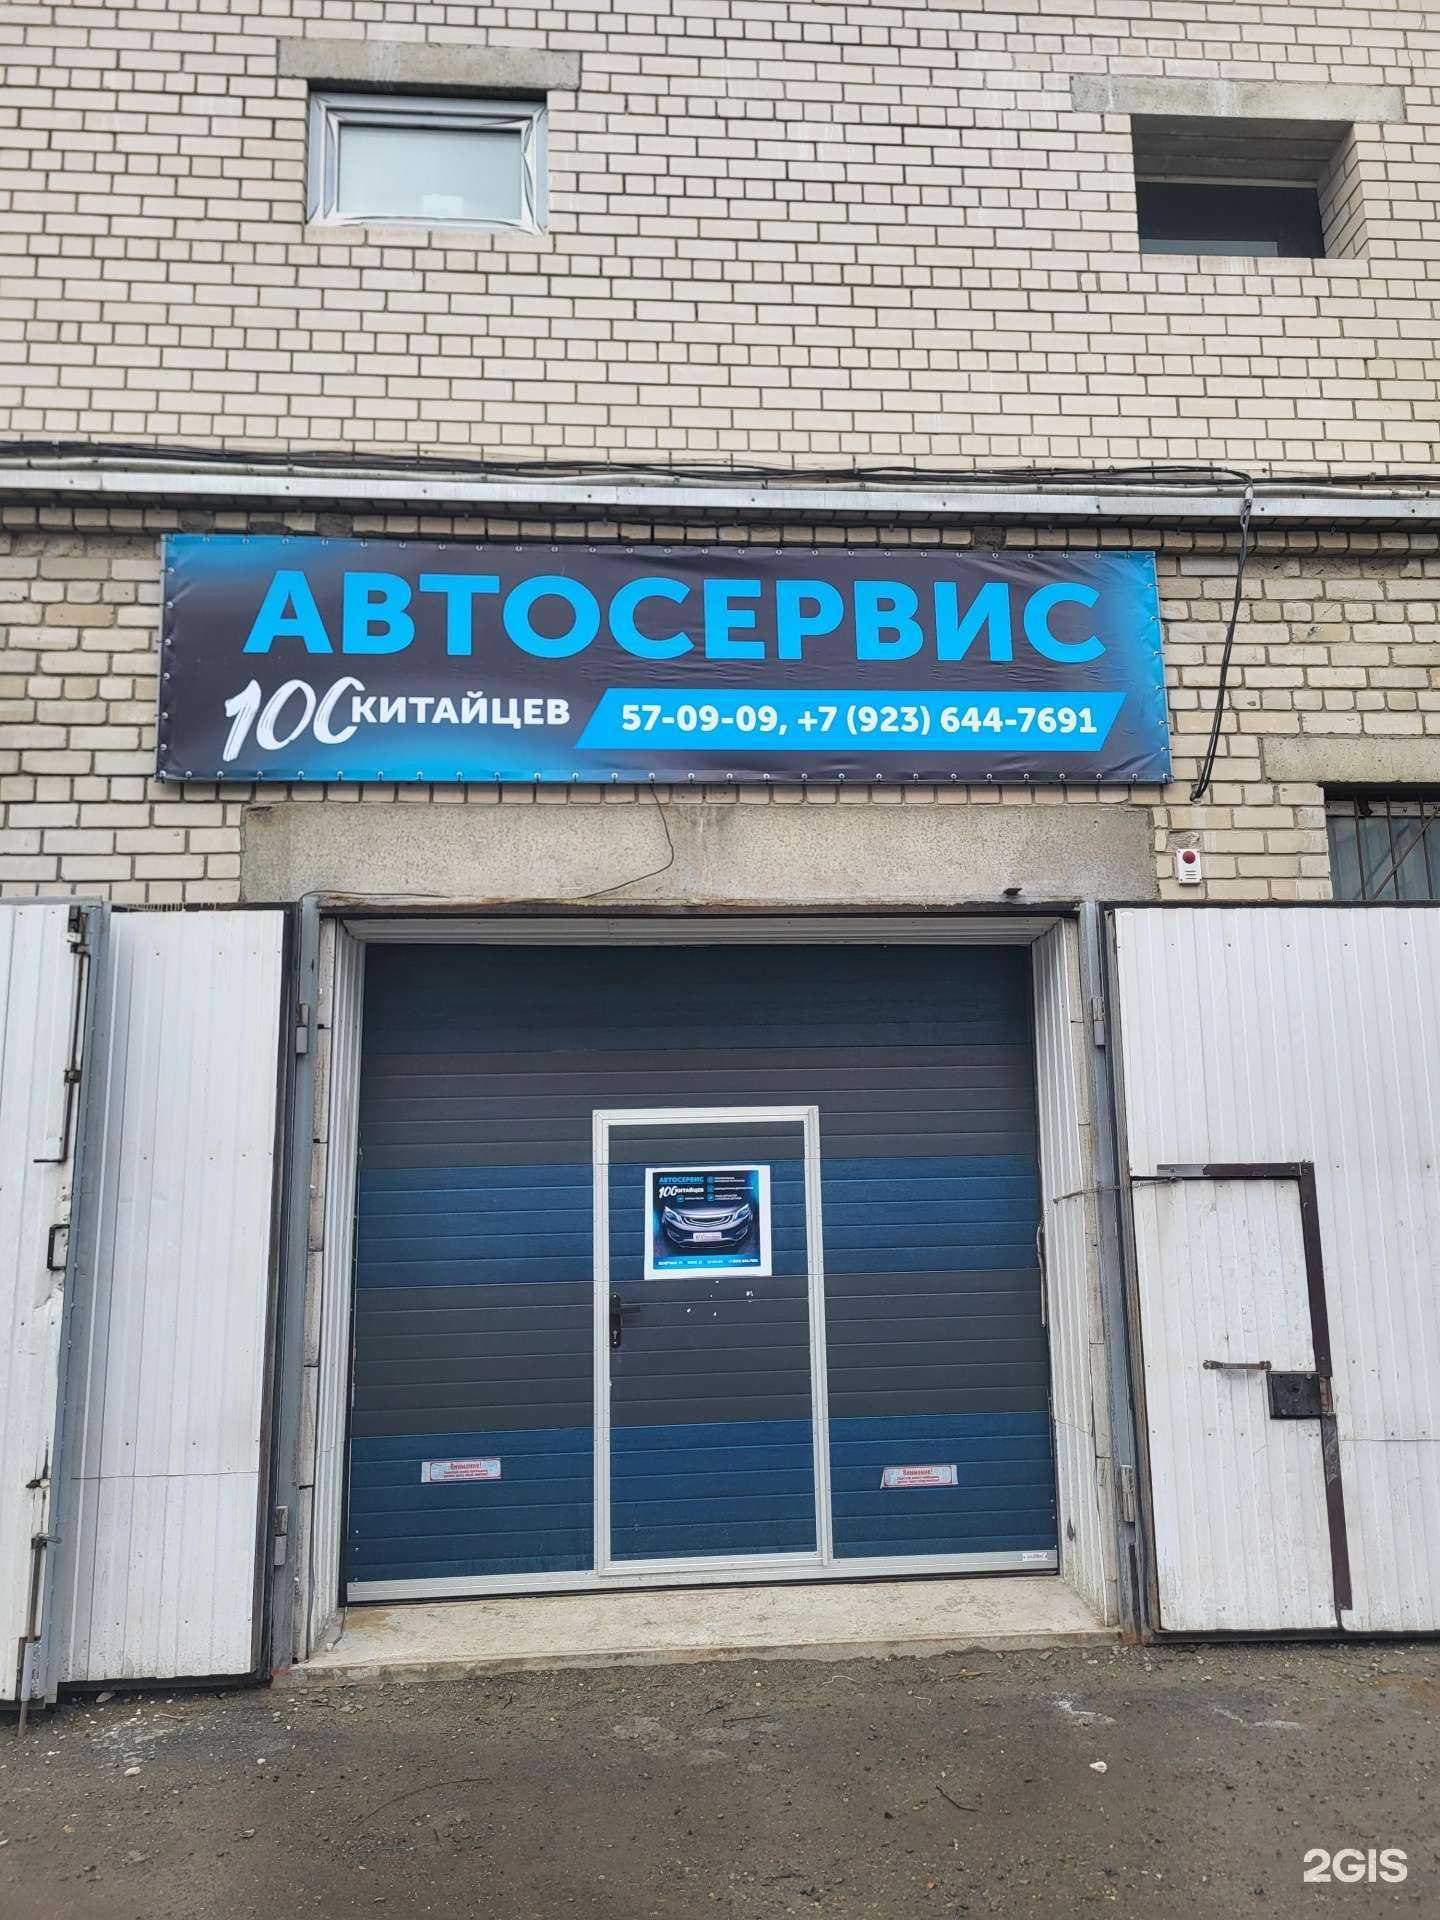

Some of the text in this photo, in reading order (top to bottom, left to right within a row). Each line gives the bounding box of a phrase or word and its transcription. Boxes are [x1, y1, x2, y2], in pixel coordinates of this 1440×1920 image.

[243, 570, 1106, 663] АВТОСЕРВИС
[352, 690, 571, 730] КИТАЙЦЕВ
[620, 704, 1098, 737] 57-09-09, +7 (923) 644-7691
